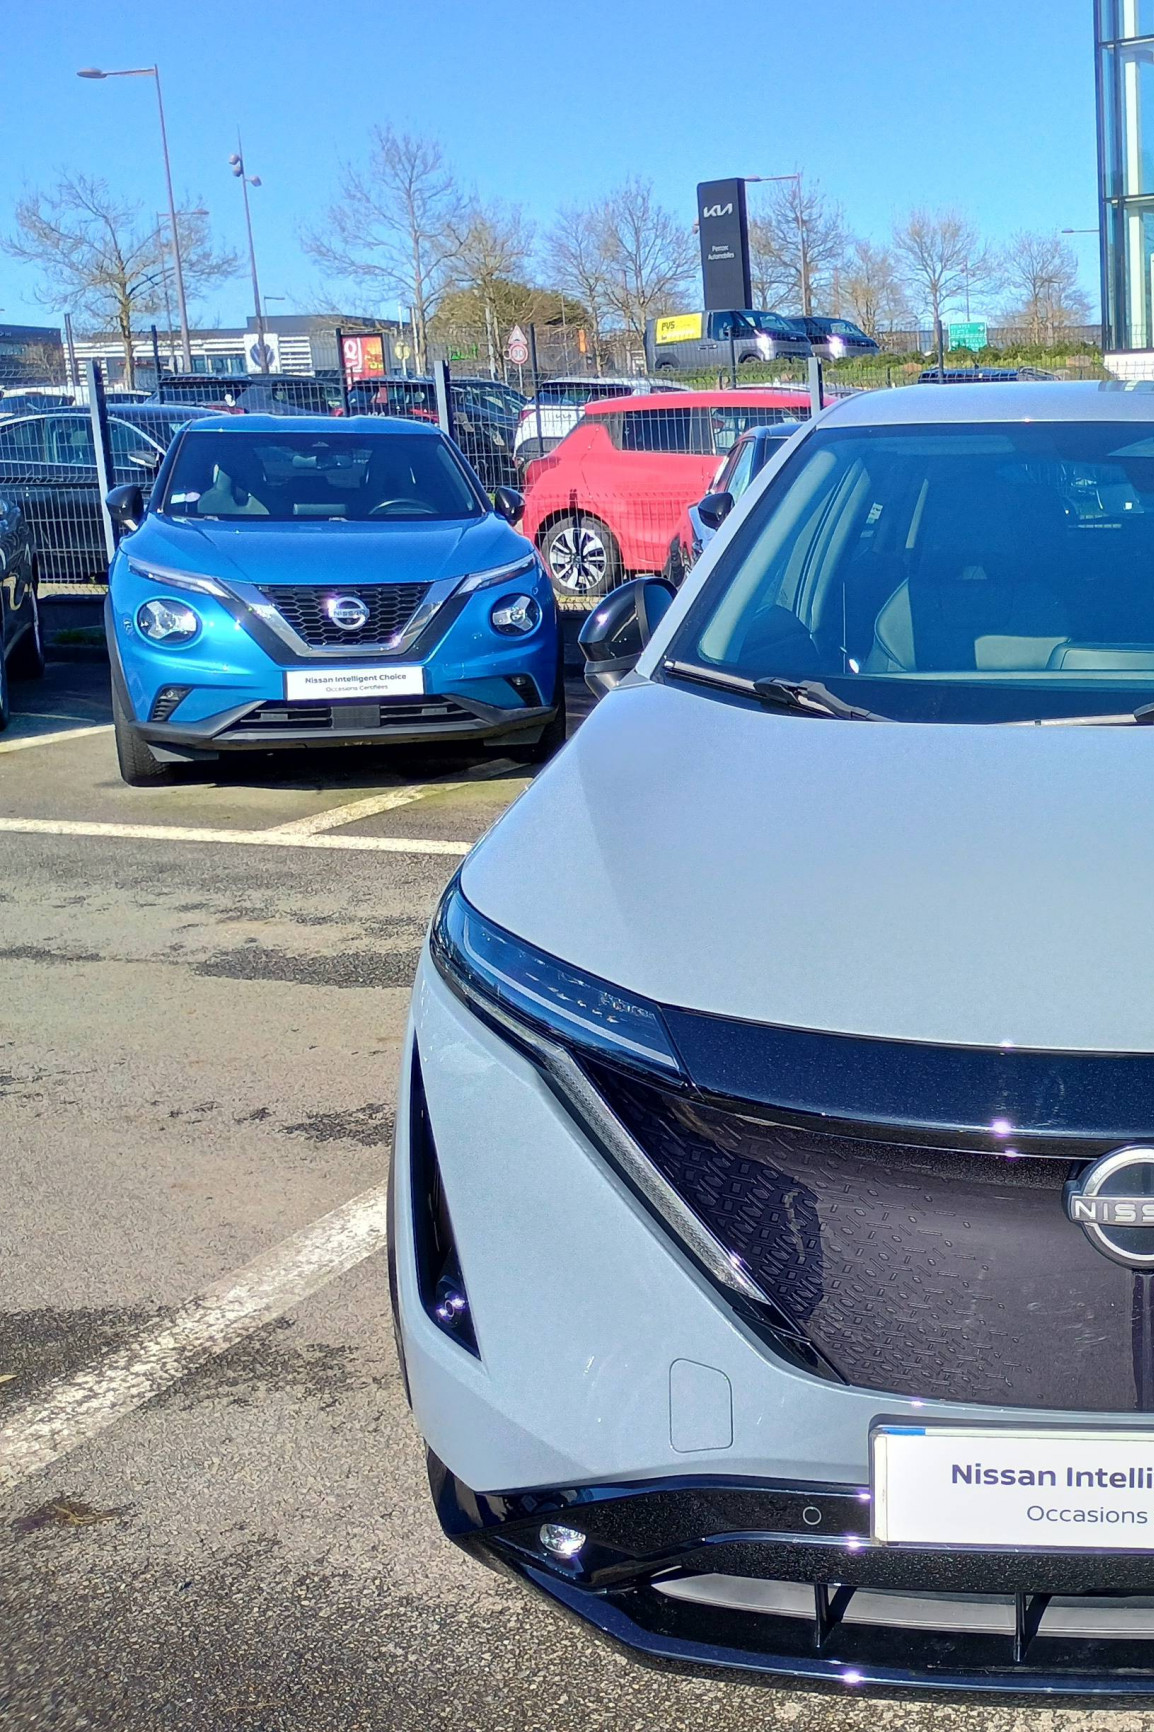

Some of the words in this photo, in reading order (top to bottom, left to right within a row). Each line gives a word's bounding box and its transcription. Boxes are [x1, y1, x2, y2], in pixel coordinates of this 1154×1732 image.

[703, 203, 733, 218] KIA
[333, 609, 366, 617] NISSAN
[335, 675, 377, 683] Intelligent
[379, 673, 407, 681] Choice
[951, 1463, 1056, 1487] Nissan
[1026, 1505, 1148, 1524] Occasions
